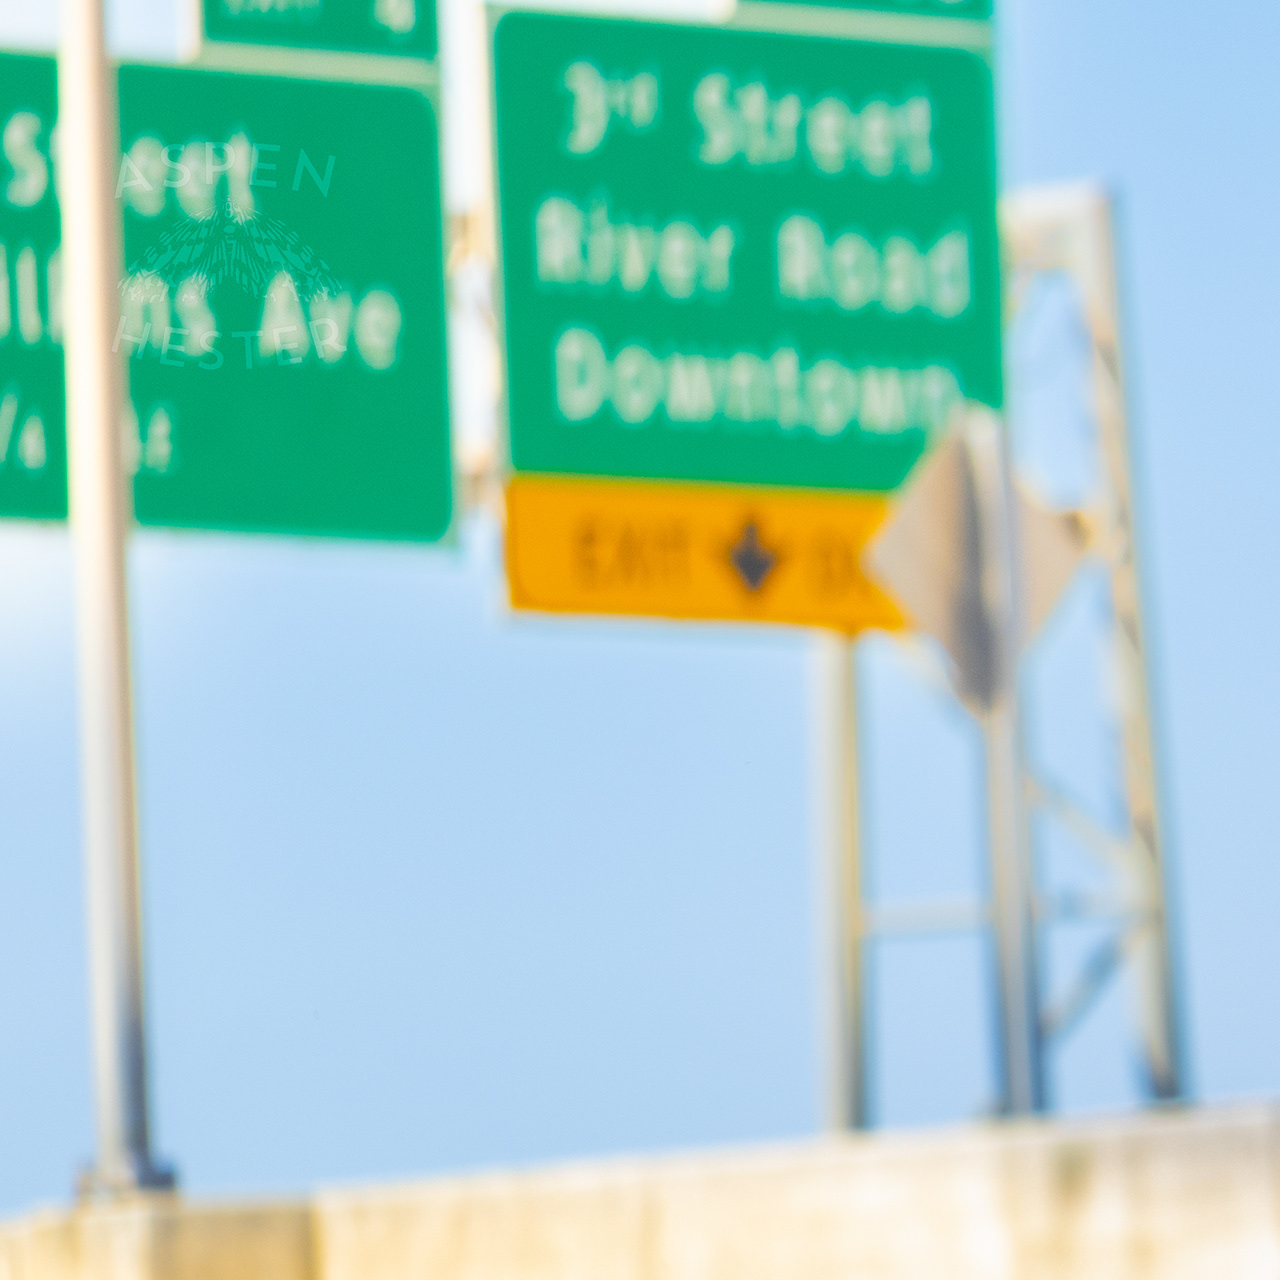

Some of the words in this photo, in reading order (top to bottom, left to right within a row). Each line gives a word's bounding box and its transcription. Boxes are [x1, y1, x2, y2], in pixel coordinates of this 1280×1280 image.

[2, 111, 255, 218] Seet
[694, 72, 934, 176] Street
[535, 194, 733, 298] River
[776, 215, 971, 317] Road
[259, 270, 402, 369] Ave
[555, 328, 963, 436] Downtown
